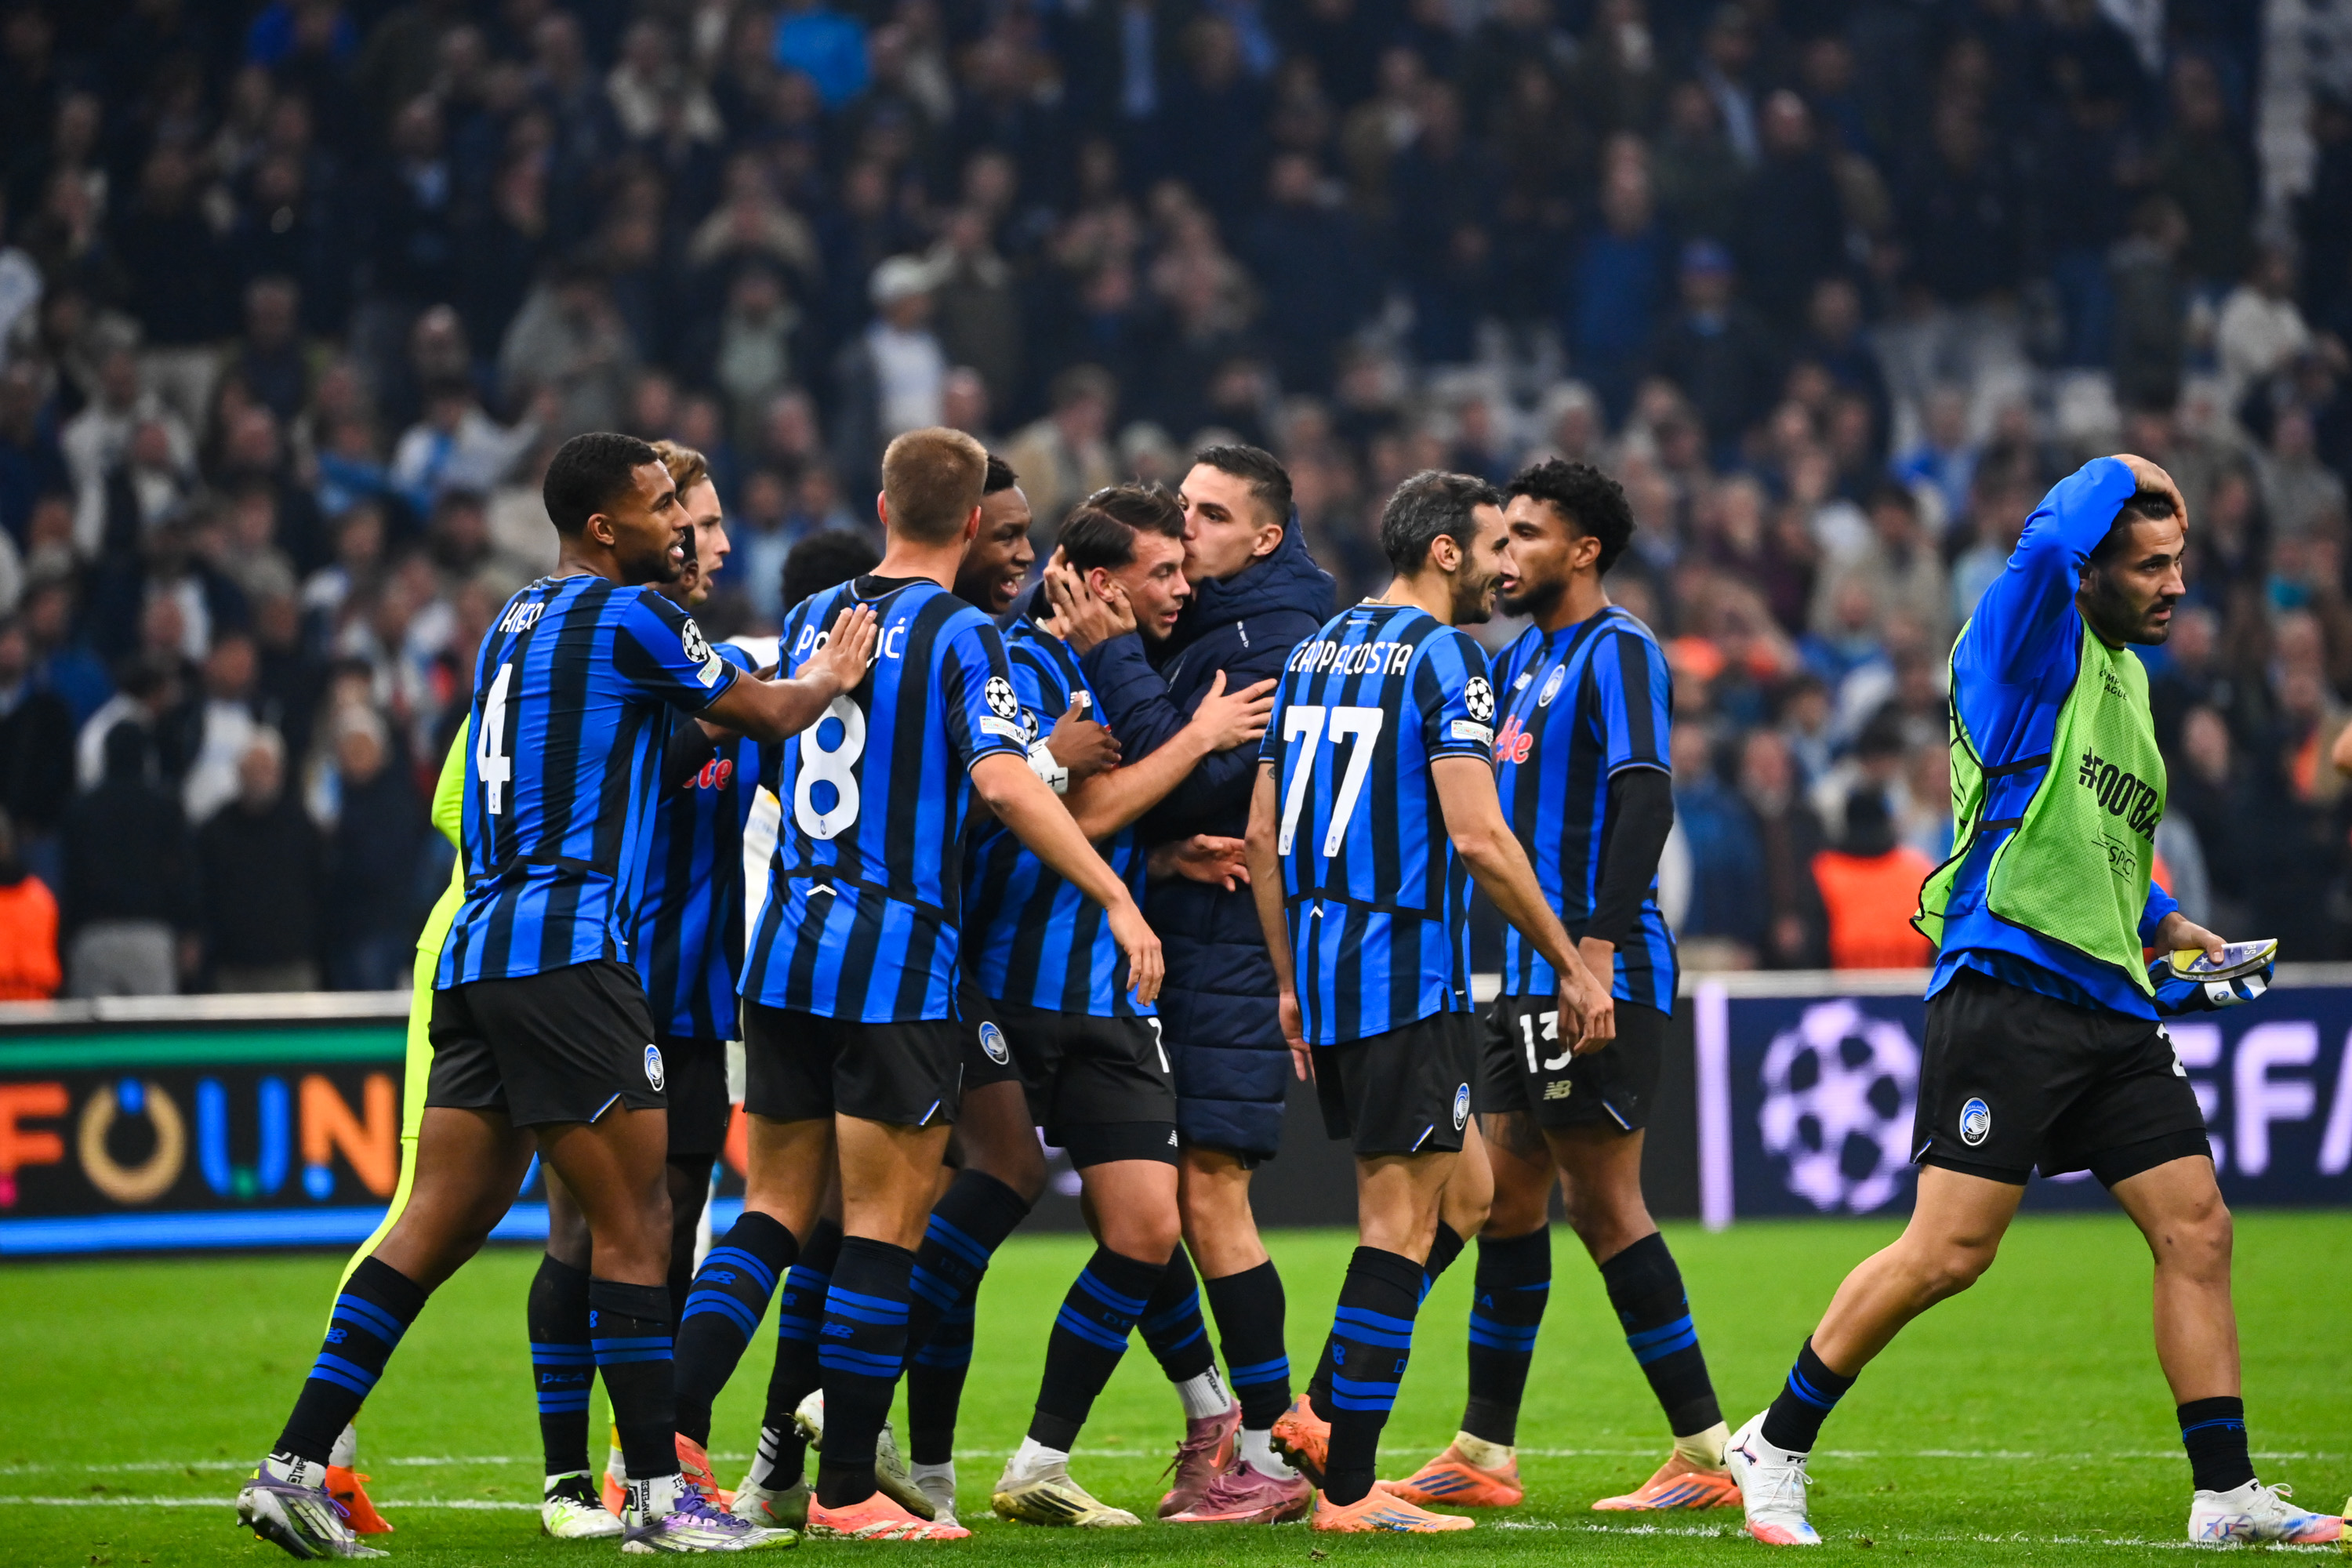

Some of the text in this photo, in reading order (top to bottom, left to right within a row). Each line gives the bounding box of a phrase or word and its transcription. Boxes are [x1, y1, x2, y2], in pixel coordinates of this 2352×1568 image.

[476, 663, 513, 815] 4
[794, 695, 866, 840] 8
[1278, 706, 1384, 857] 77
[1519, 1011, 1573, 1073] 13
